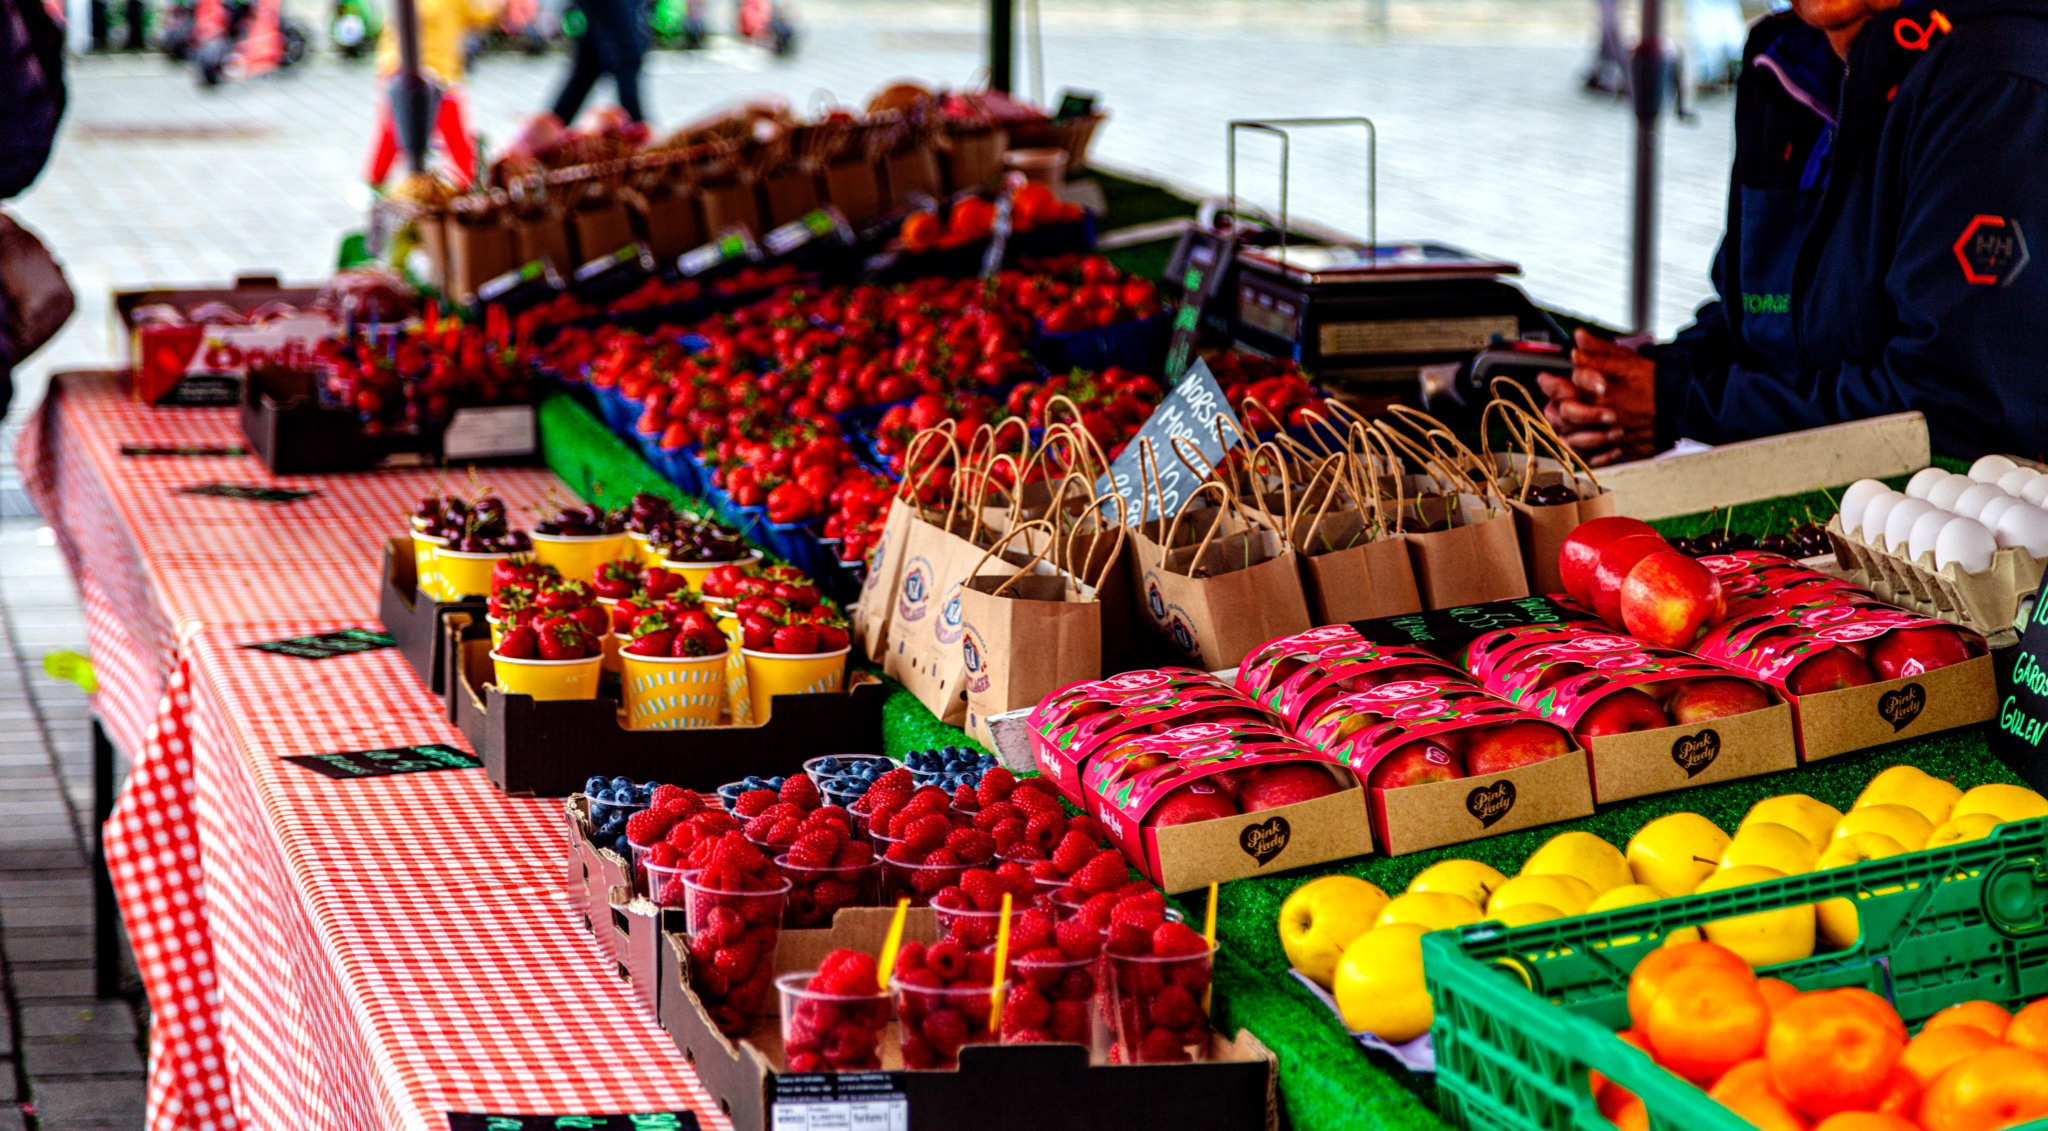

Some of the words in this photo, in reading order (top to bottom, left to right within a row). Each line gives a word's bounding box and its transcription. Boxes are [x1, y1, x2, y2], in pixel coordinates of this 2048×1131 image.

[1175, 373, 1233, 443] NORSKE
[1885, 687, 1917, 713] Pink
[1890, 700, 1920, 722] Lady
[1679, 733, 1712, 759] Pink
[1684, 746, 1715, 768] Lady
[1473, 783, 1508, 810] Pink
[1479, 796, 1510, 819] Lady
[1247, 820, 1281, 848] Pink
[1254, 834, 1285, 857] Lady
